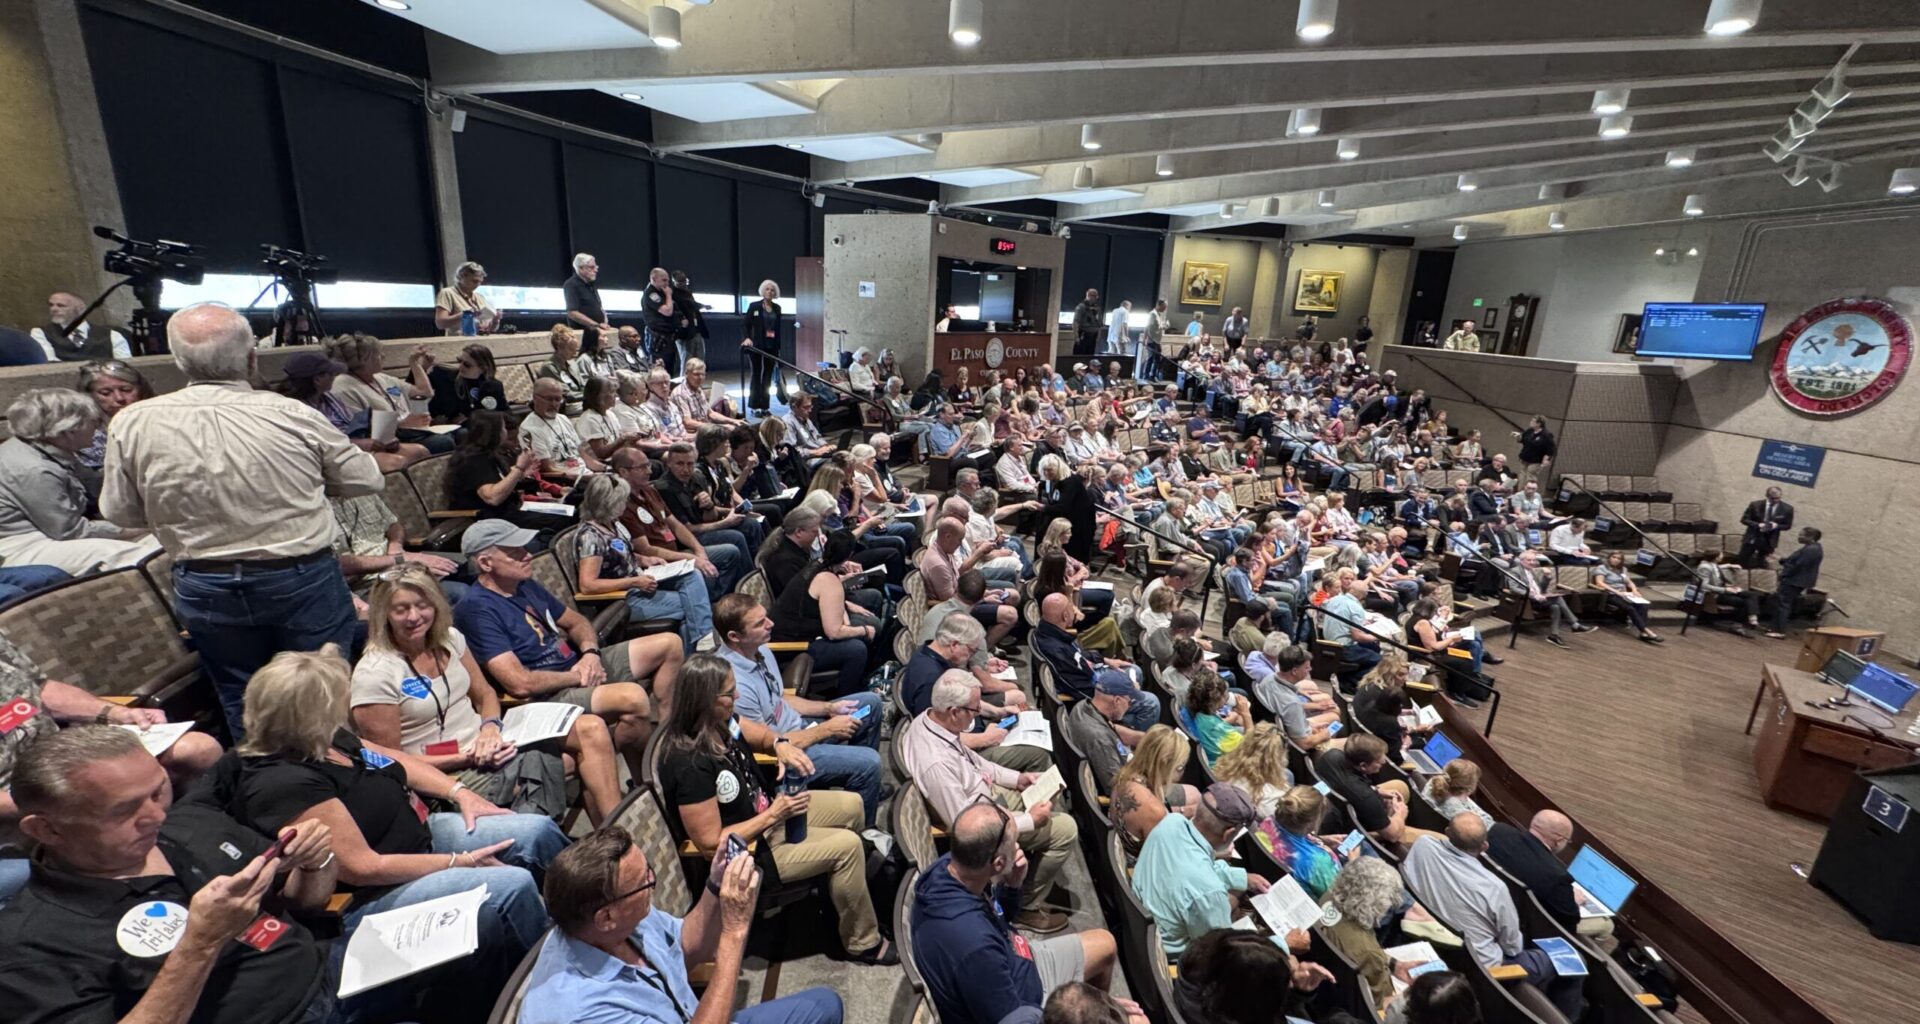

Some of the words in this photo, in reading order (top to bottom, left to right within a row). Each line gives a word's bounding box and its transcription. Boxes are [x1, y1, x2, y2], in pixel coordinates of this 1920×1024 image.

[951, 348, 962, 361] EL
[964, 347, 985, 360] PASO
[1005, 346, 1039, 358] COUNTY
[1818, 370, 1898, 412] COLORADO
[1878, 802, 1891, 816] 3
[121, 918, 153, 938] We
